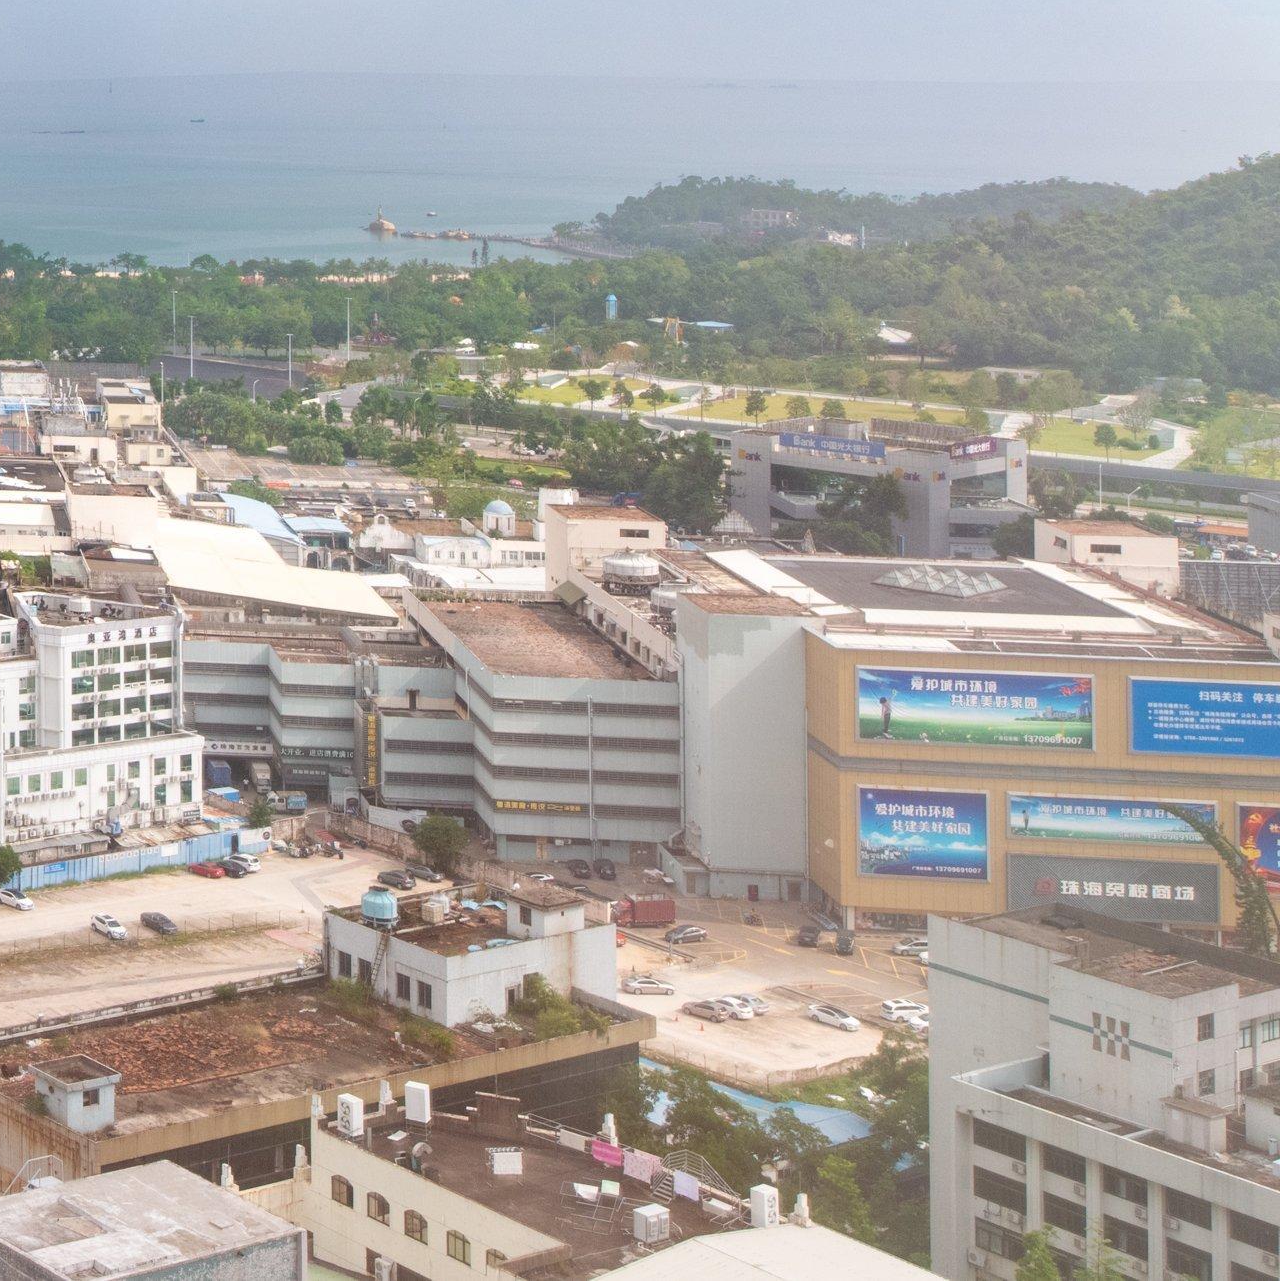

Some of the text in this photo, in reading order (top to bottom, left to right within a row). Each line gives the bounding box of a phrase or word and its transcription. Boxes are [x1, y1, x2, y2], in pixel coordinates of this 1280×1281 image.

[910, 675, 998, 694] 爱护城市环境
[950, 694, 1039, 710] 共建美好家园
[1198, 690, 1244, 703] 扫码关注
[1023, 733, 1083, 745] 13709691007
[874, 802, 955, 819] 爱护城市环境
[891, 819, 972, 835] 共建美好家园
[1060, 878, 1196, 901] 珠海免税商场
